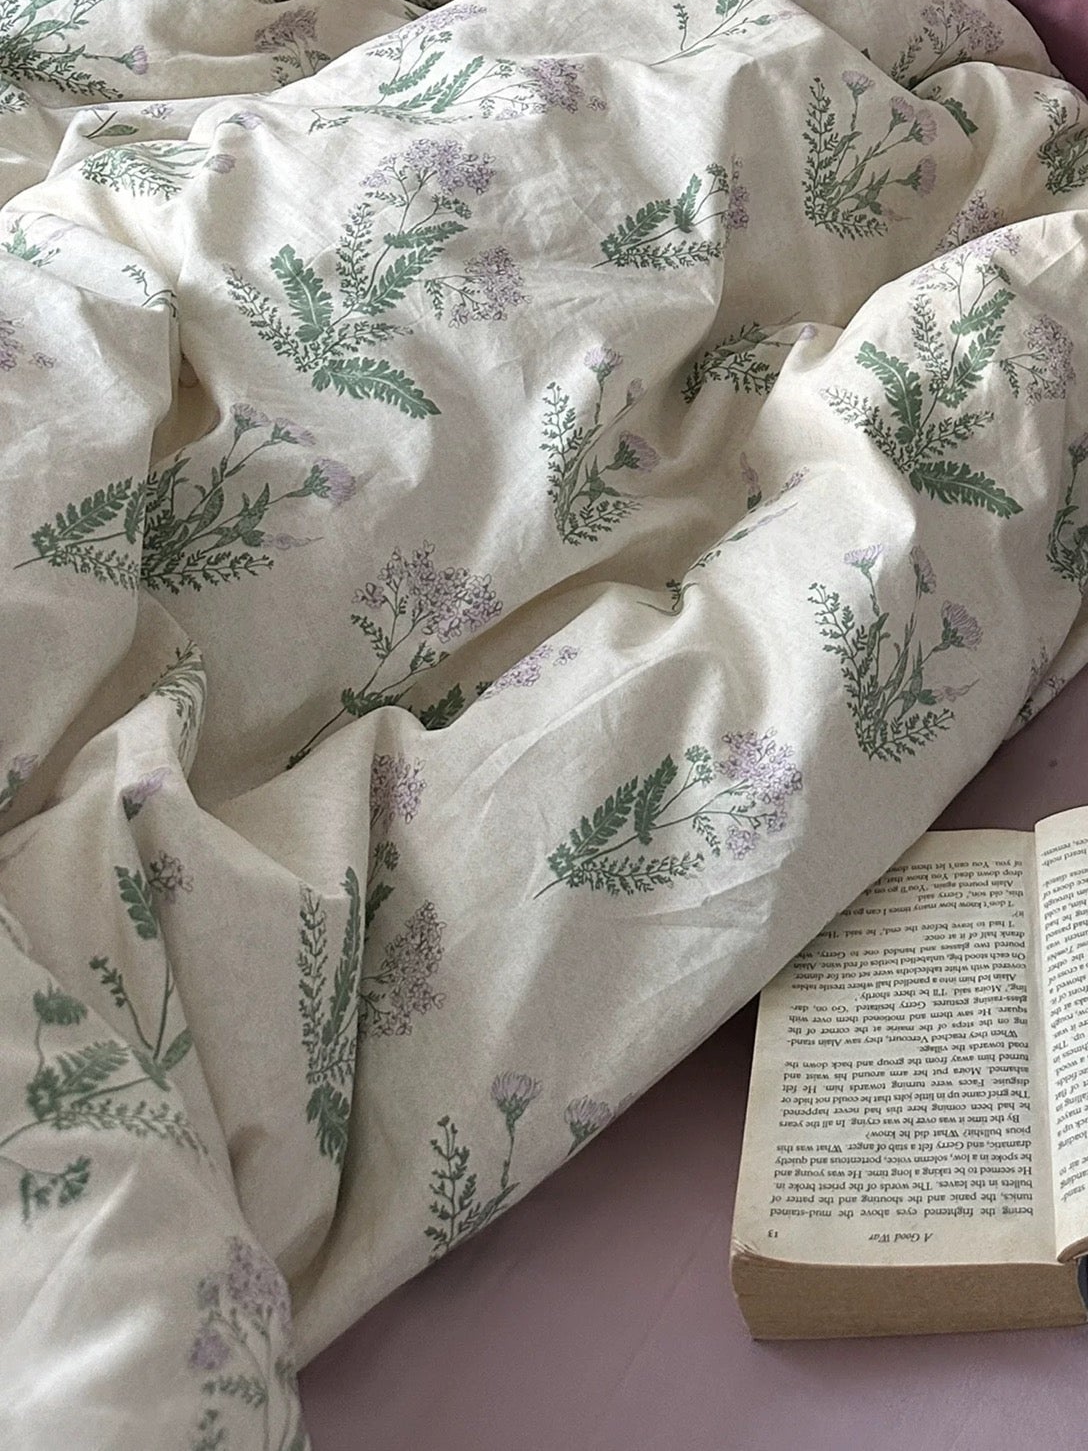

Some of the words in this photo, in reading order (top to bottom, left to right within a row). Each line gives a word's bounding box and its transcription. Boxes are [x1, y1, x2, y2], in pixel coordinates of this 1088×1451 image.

[951, 1044, 966, 1052] the
[968, 1041, 1004, 1052] towards
[1008, 1041, 1028, 1050] road
[865, 1130, 896, 1140] know?
[899, 1130, 910, 1139] he
[914, 1130, 930, 1139] did
[932, 1130, 960, 1138] What
[1006, 1126, 1031, 1136] pious
[788, 1183, 816, 1192] broke
[818, 1182, 846, 1192] priest
[848, 1183, 864, 1192] the
[865, 1183, 877, 1192] of
[880, 1182, 910, 1192] words
[912, 1182, 932, 1191] The
[970, 1180, 986, 1189] the
[988, 1180, 998, 1188] in
[1001, 1180, 1033, 1188] bullets
[770, 1196, 782, 1204] of
[786, 1195, 815, 1204] patter
[818, 1196, 834, 1206] the
[838, 1196, 857, 1205] and
[861, 1194, 904, 1204] shouting
[908, 1196, 922, 1204] the
[927, 1194, 946, 1204] and
[950, 1192, 976, 1203] panic
[980, 1194, 996, 1203] the
[1000, 1192, 1033, 1202] tunics,
[770, 1208, 832, 1218] mud-stained
[838, 1210, 854, 1219] the
[860, 1210, 890, 1218] above
[896, 1207, 918, 1216] eyes
[924, 1206, 974, 1218] frightened
[980, 1208, 996, 1218] the
[768, 1230, 778, 1238] 13
[868, 1233, 890, 1243] War
[894, 1232, 920, 1243] Good
[924, 1232, 934, 1243] A
